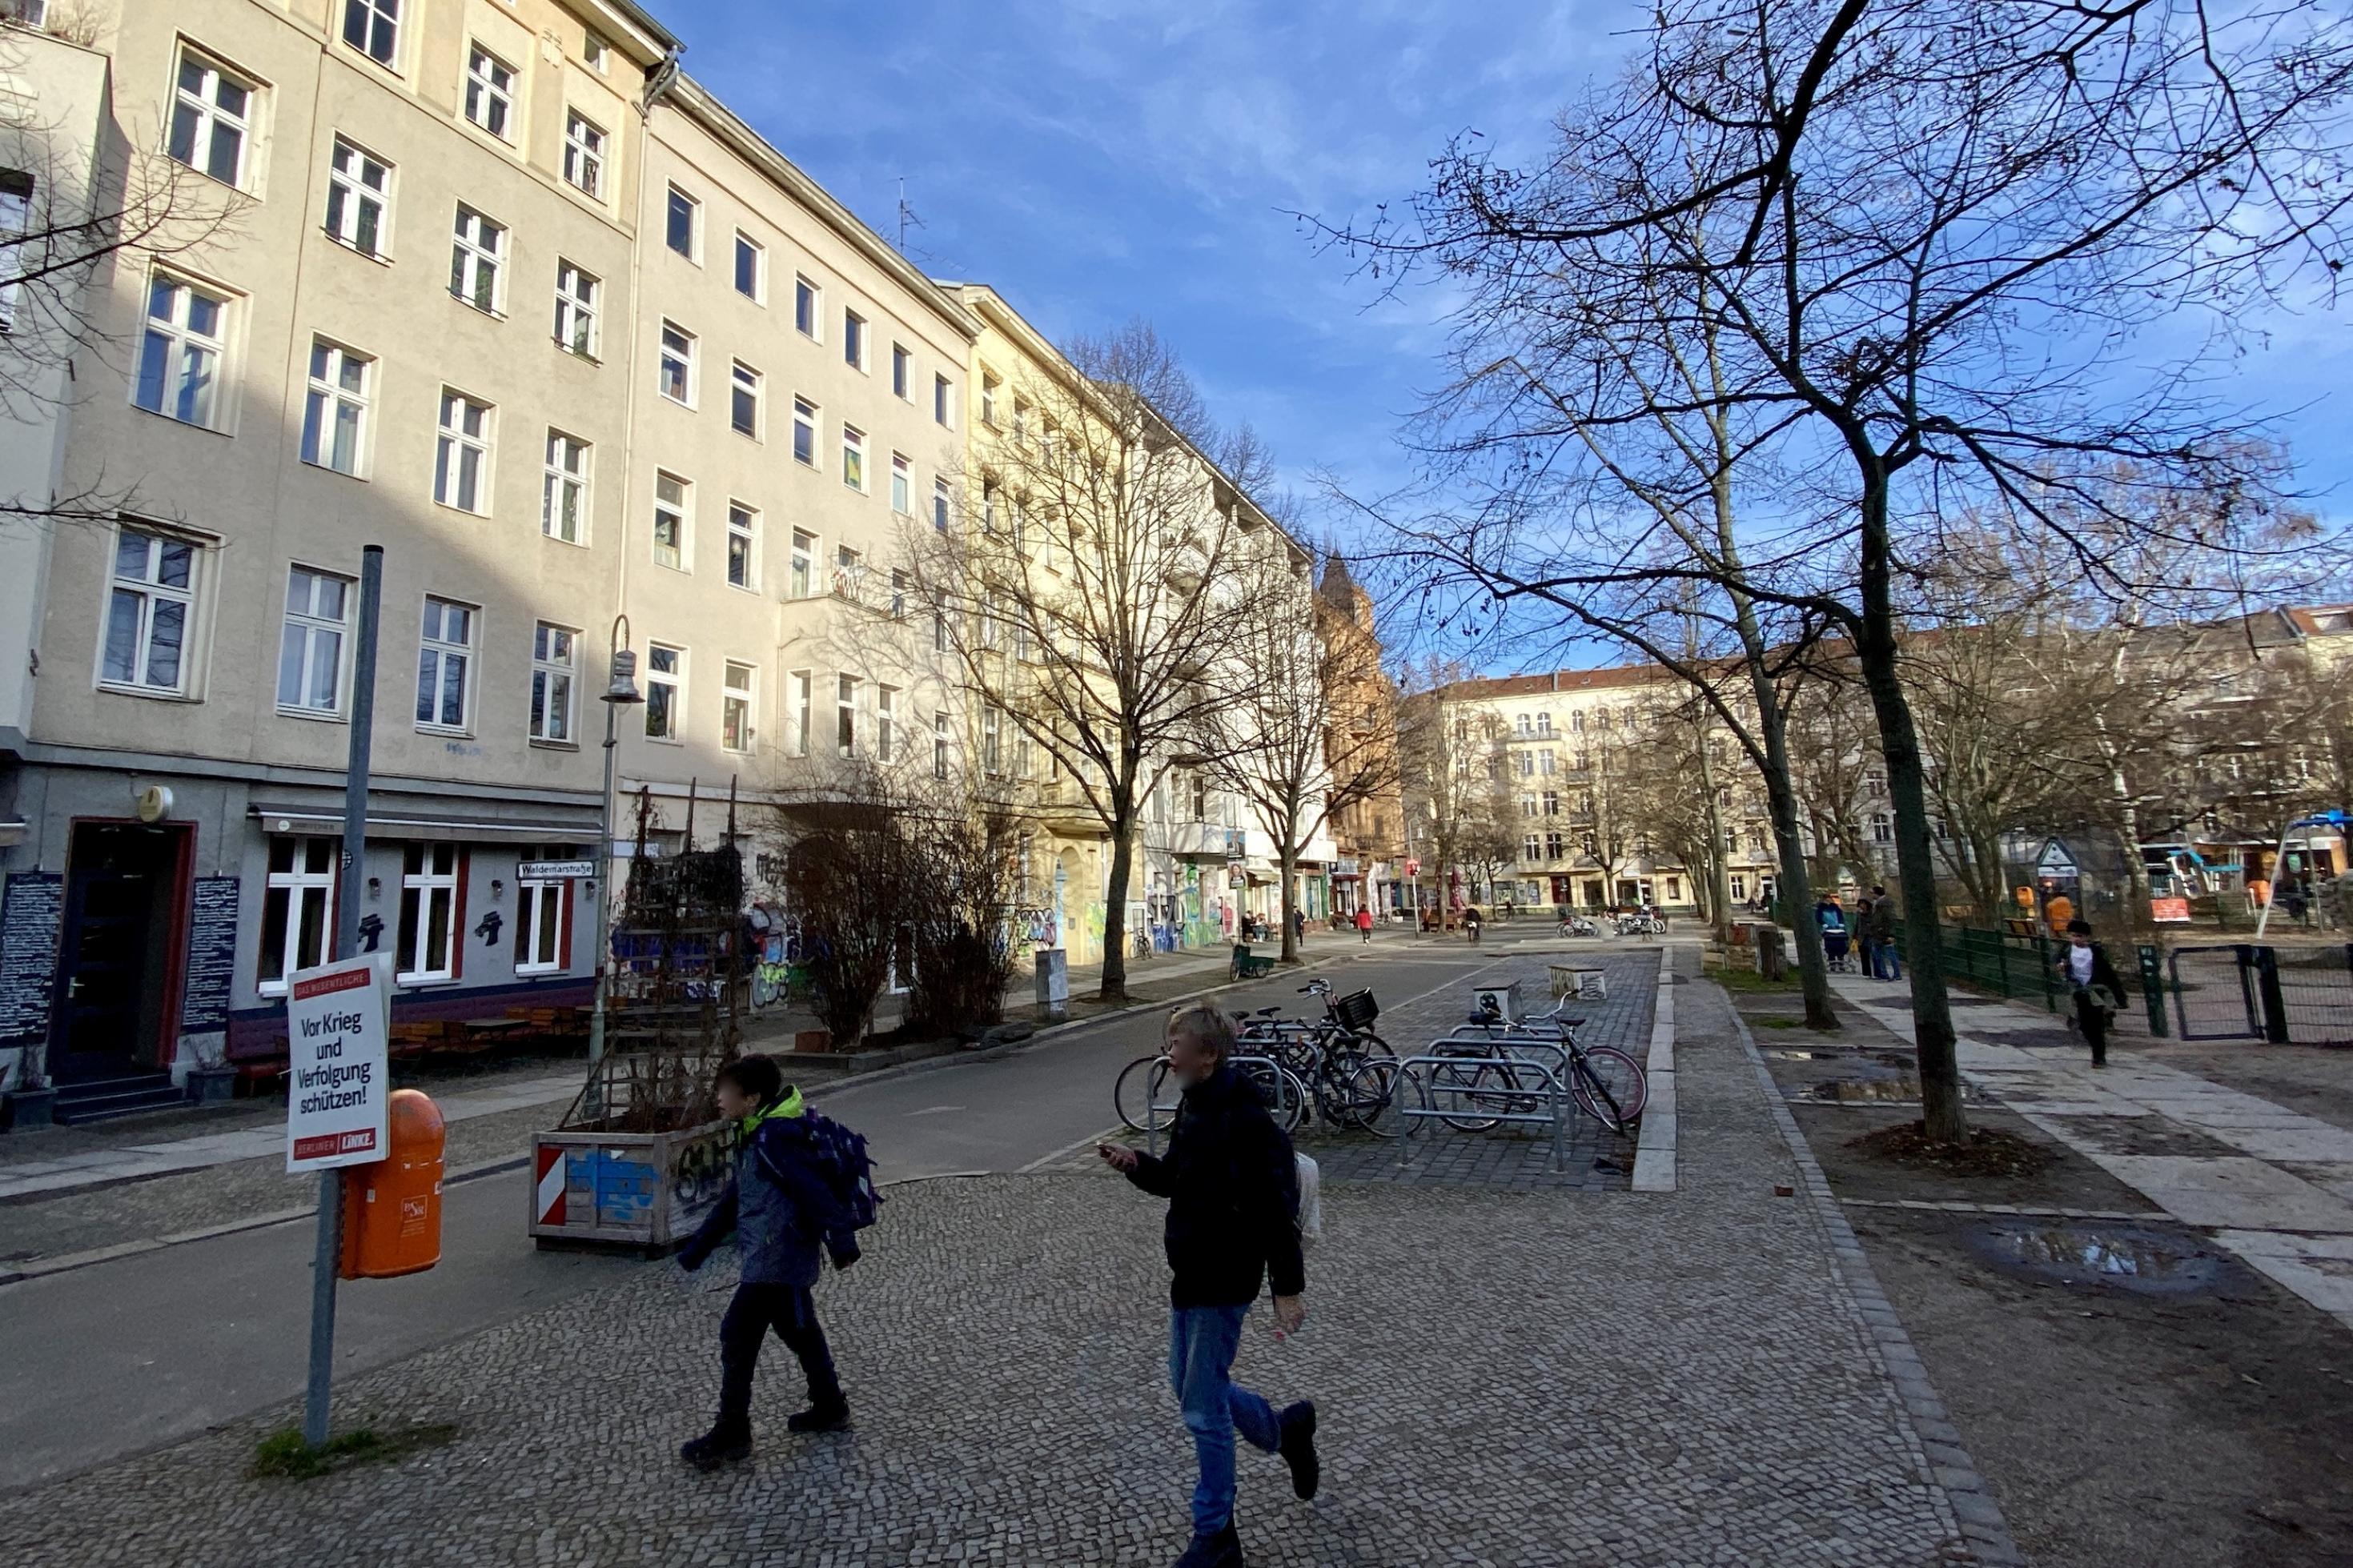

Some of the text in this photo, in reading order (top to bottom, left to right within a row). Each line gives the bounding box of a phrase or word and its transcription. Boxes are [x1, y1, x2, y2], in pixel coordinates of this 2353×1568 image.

[522, 864, 592, 874] Waldemarstraße
[295, 985, 309, 996] DAS
[301, 1011, 363, 1037] Vor Krieg
[316, 1037, 342, 1060] und
[297, 1061, 371, 1089] Verfolgung
[300, 1085, 367, 1114] schützen!
[297, 1140, 335, 1153] BERLINER
